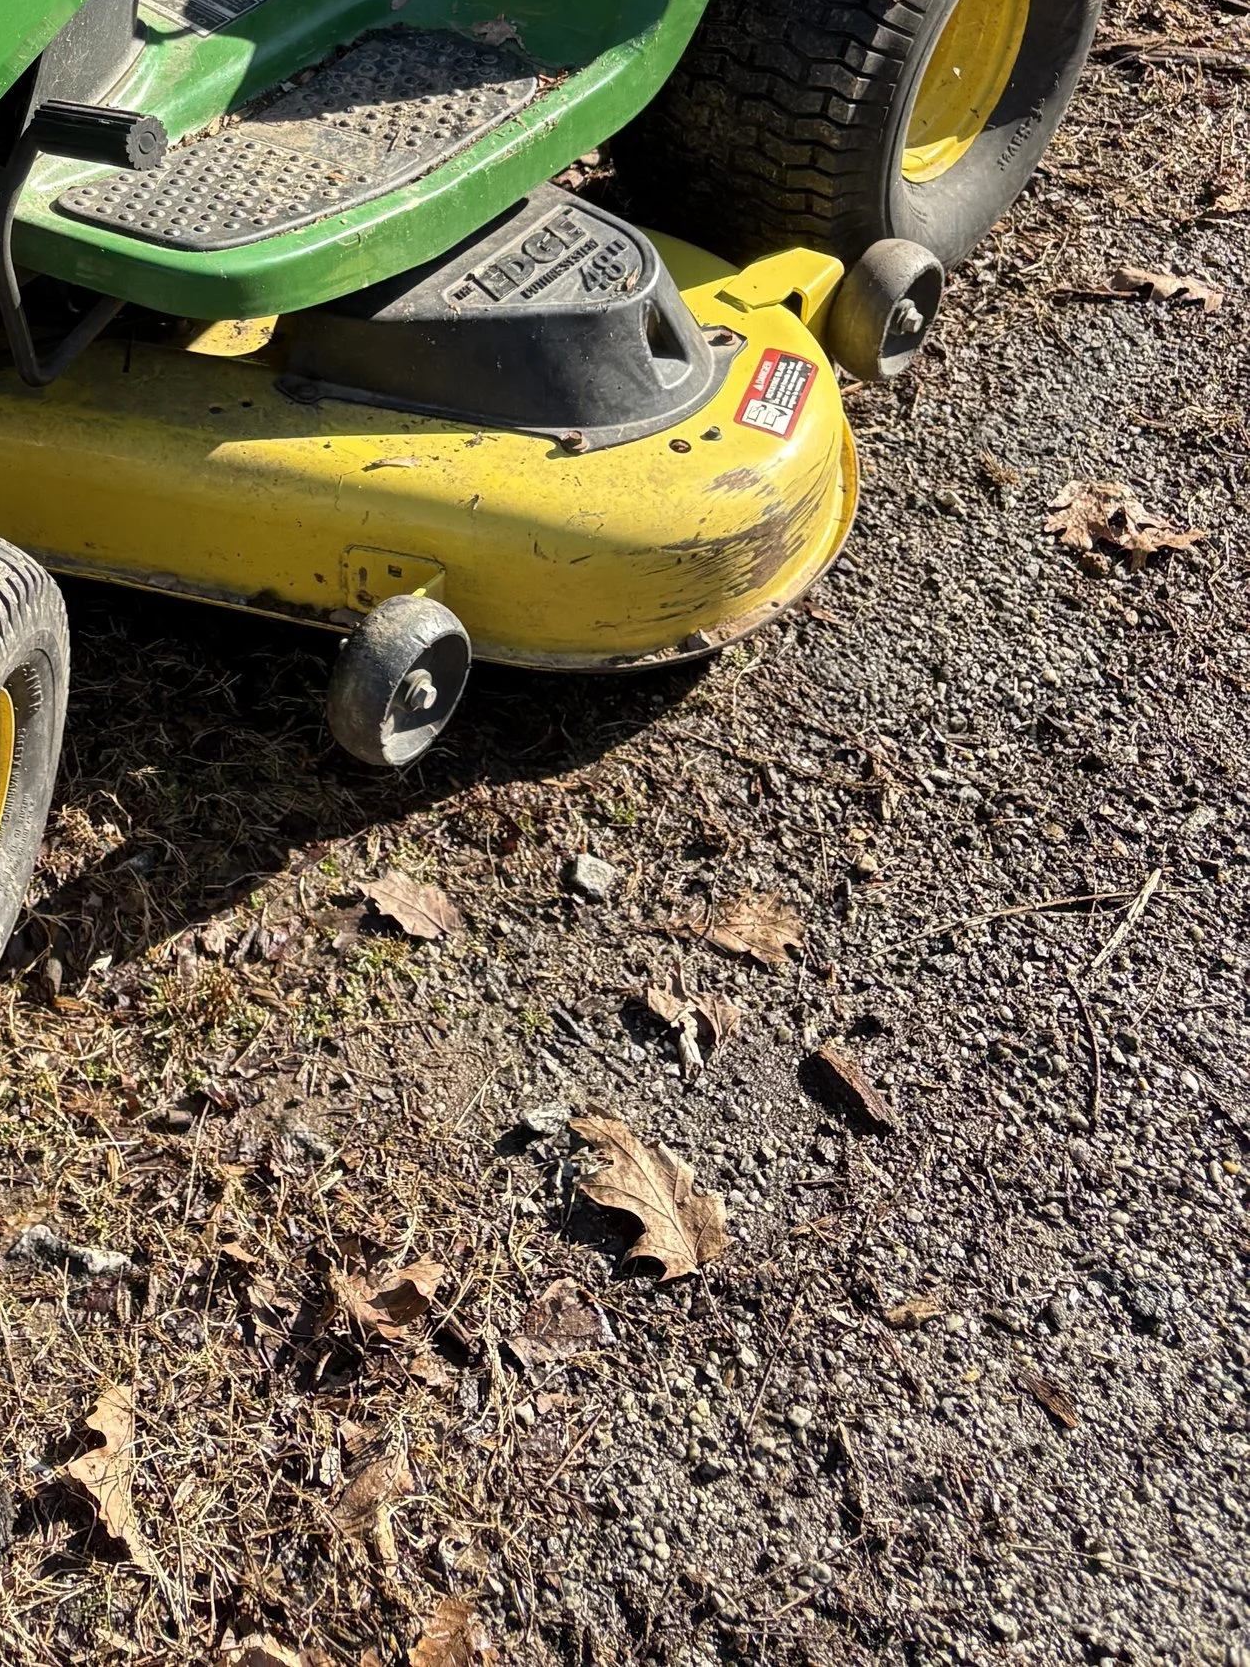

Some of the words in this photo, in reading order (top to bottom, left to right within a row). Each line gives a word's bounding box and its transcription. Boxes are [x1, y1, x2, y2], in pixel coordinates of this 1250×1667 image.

[463, 208, 588, 302] EDGE
[578, 238, 628, 293] 48"
[12, 727, 27, 770] SAFETY
